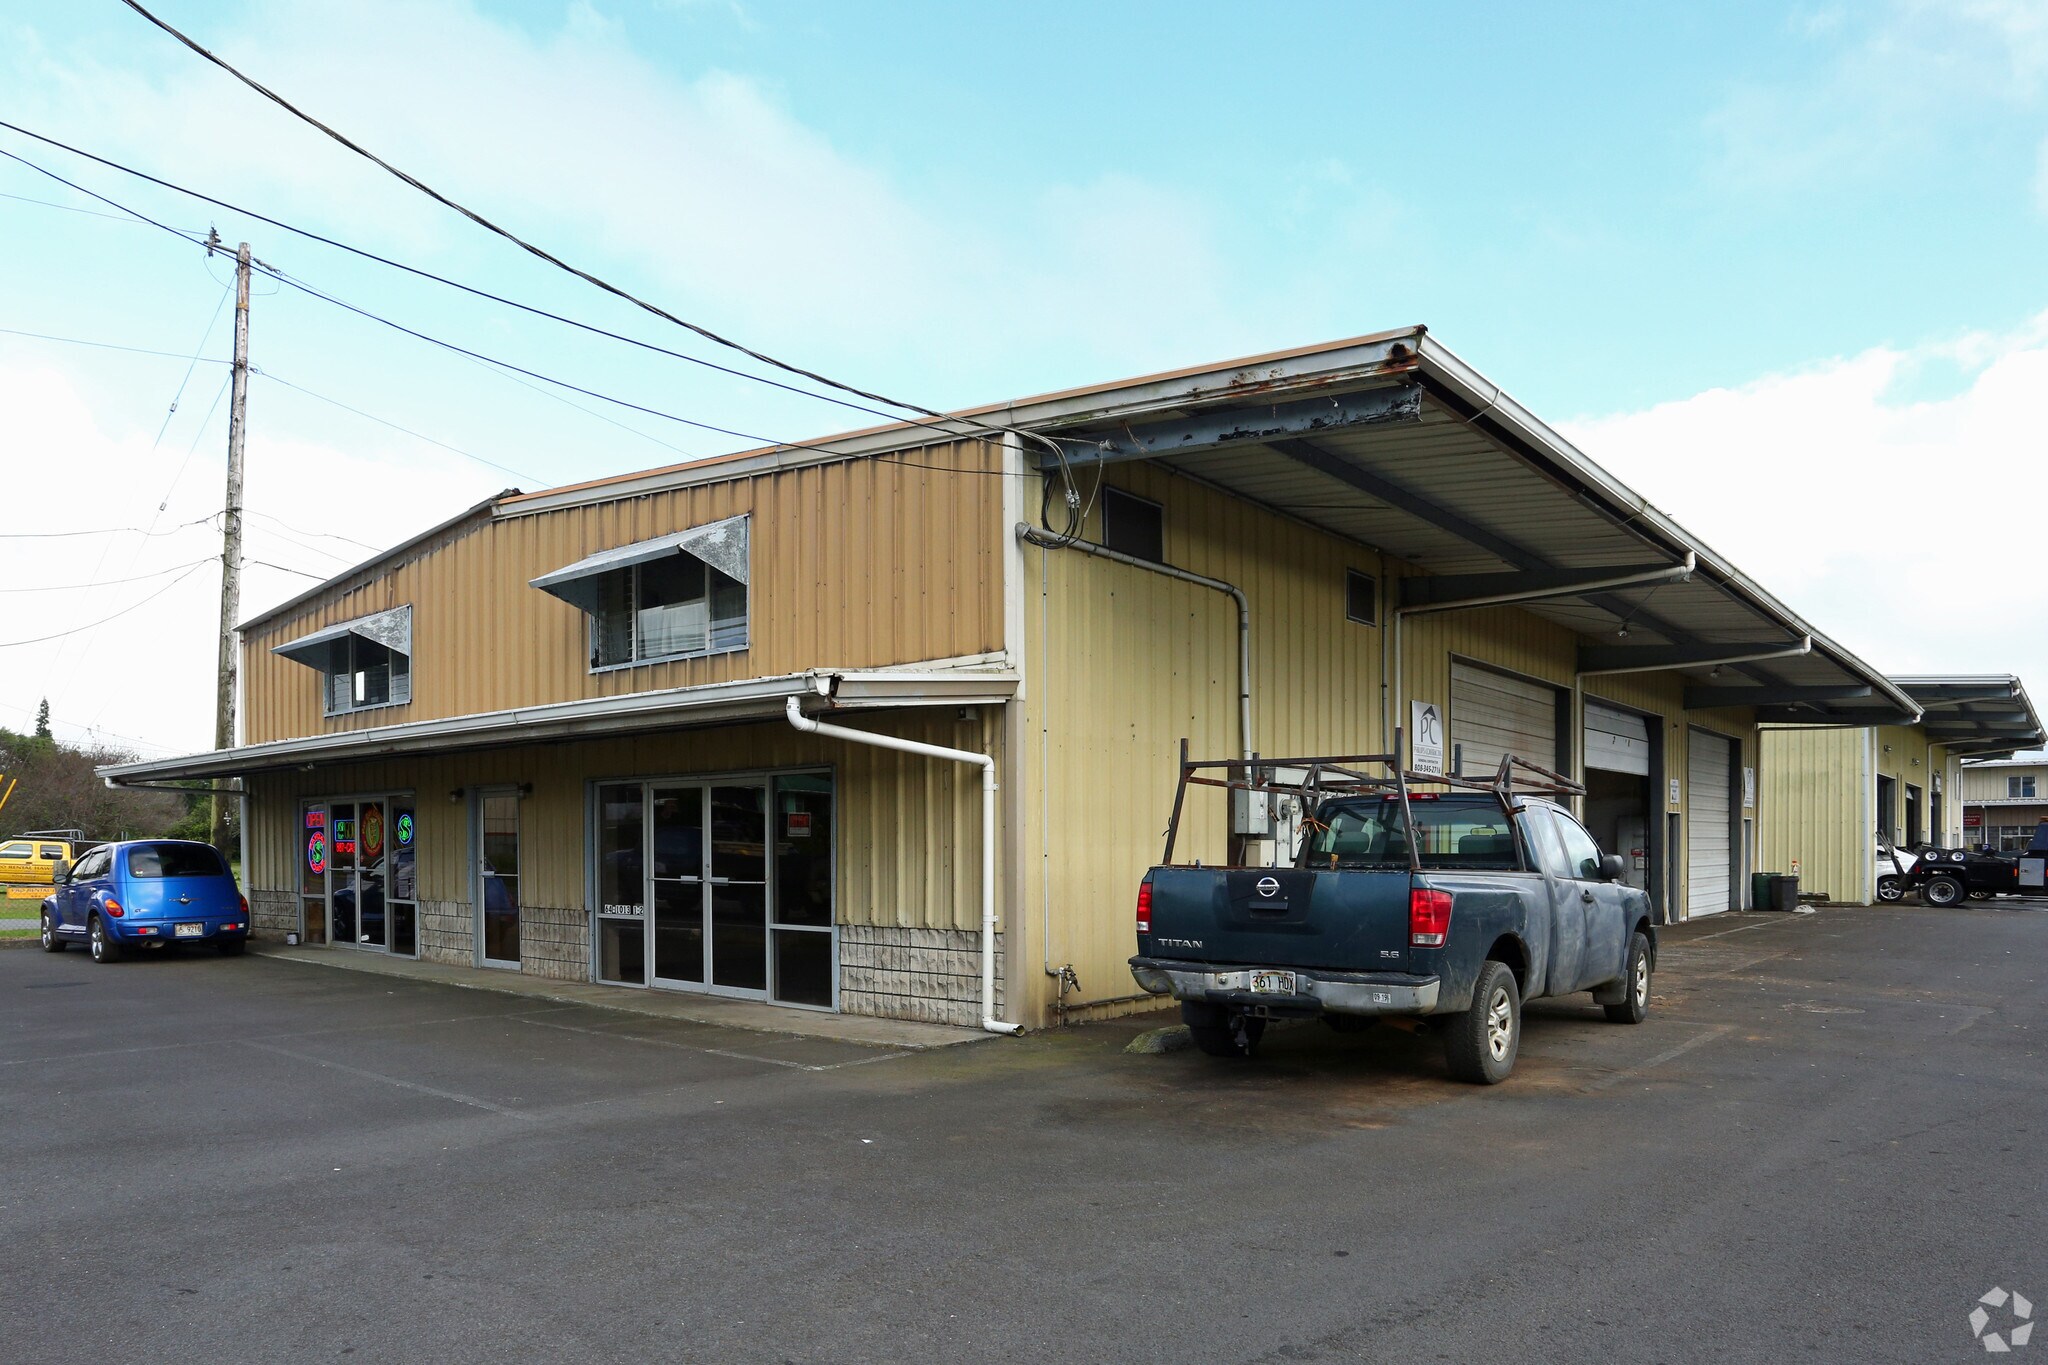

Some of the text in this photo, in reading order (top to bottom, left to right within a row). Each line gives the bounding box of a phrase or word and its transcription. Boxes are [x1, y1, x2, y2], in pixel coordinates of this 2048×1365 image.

[1420, 716, 1437, 744] PC
[1158, 938, 1203, 948] TITAN
[1252, 975, 1294, 991] 361 HDX
